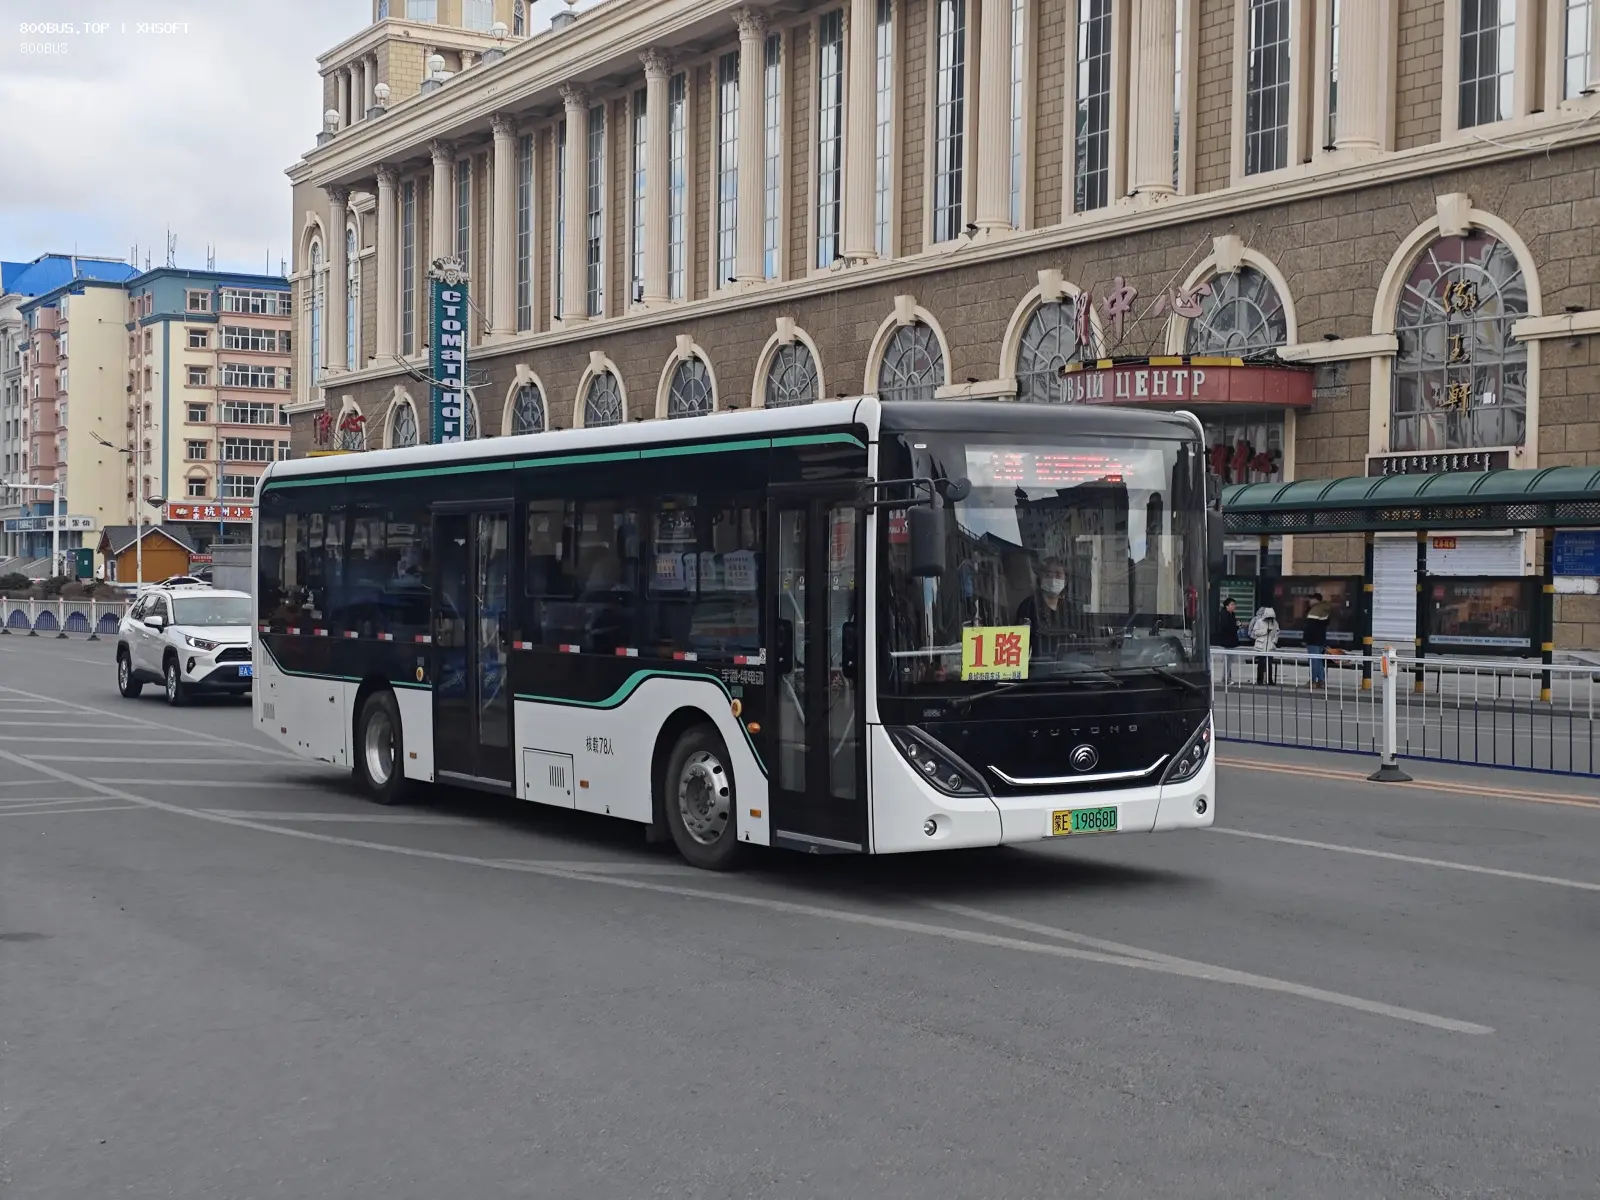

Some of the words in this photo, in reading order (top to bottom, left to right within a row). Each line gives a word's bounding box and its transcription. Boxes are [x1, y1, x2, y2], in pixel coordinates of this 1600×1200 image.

[1116, 370, 1206, 398] ЦЕНТР
[969, 632, 1022, 667] 1路
[1029, 724, 1138, 738] YUTONG
[1075, 810, 1116, 830] 19868D
